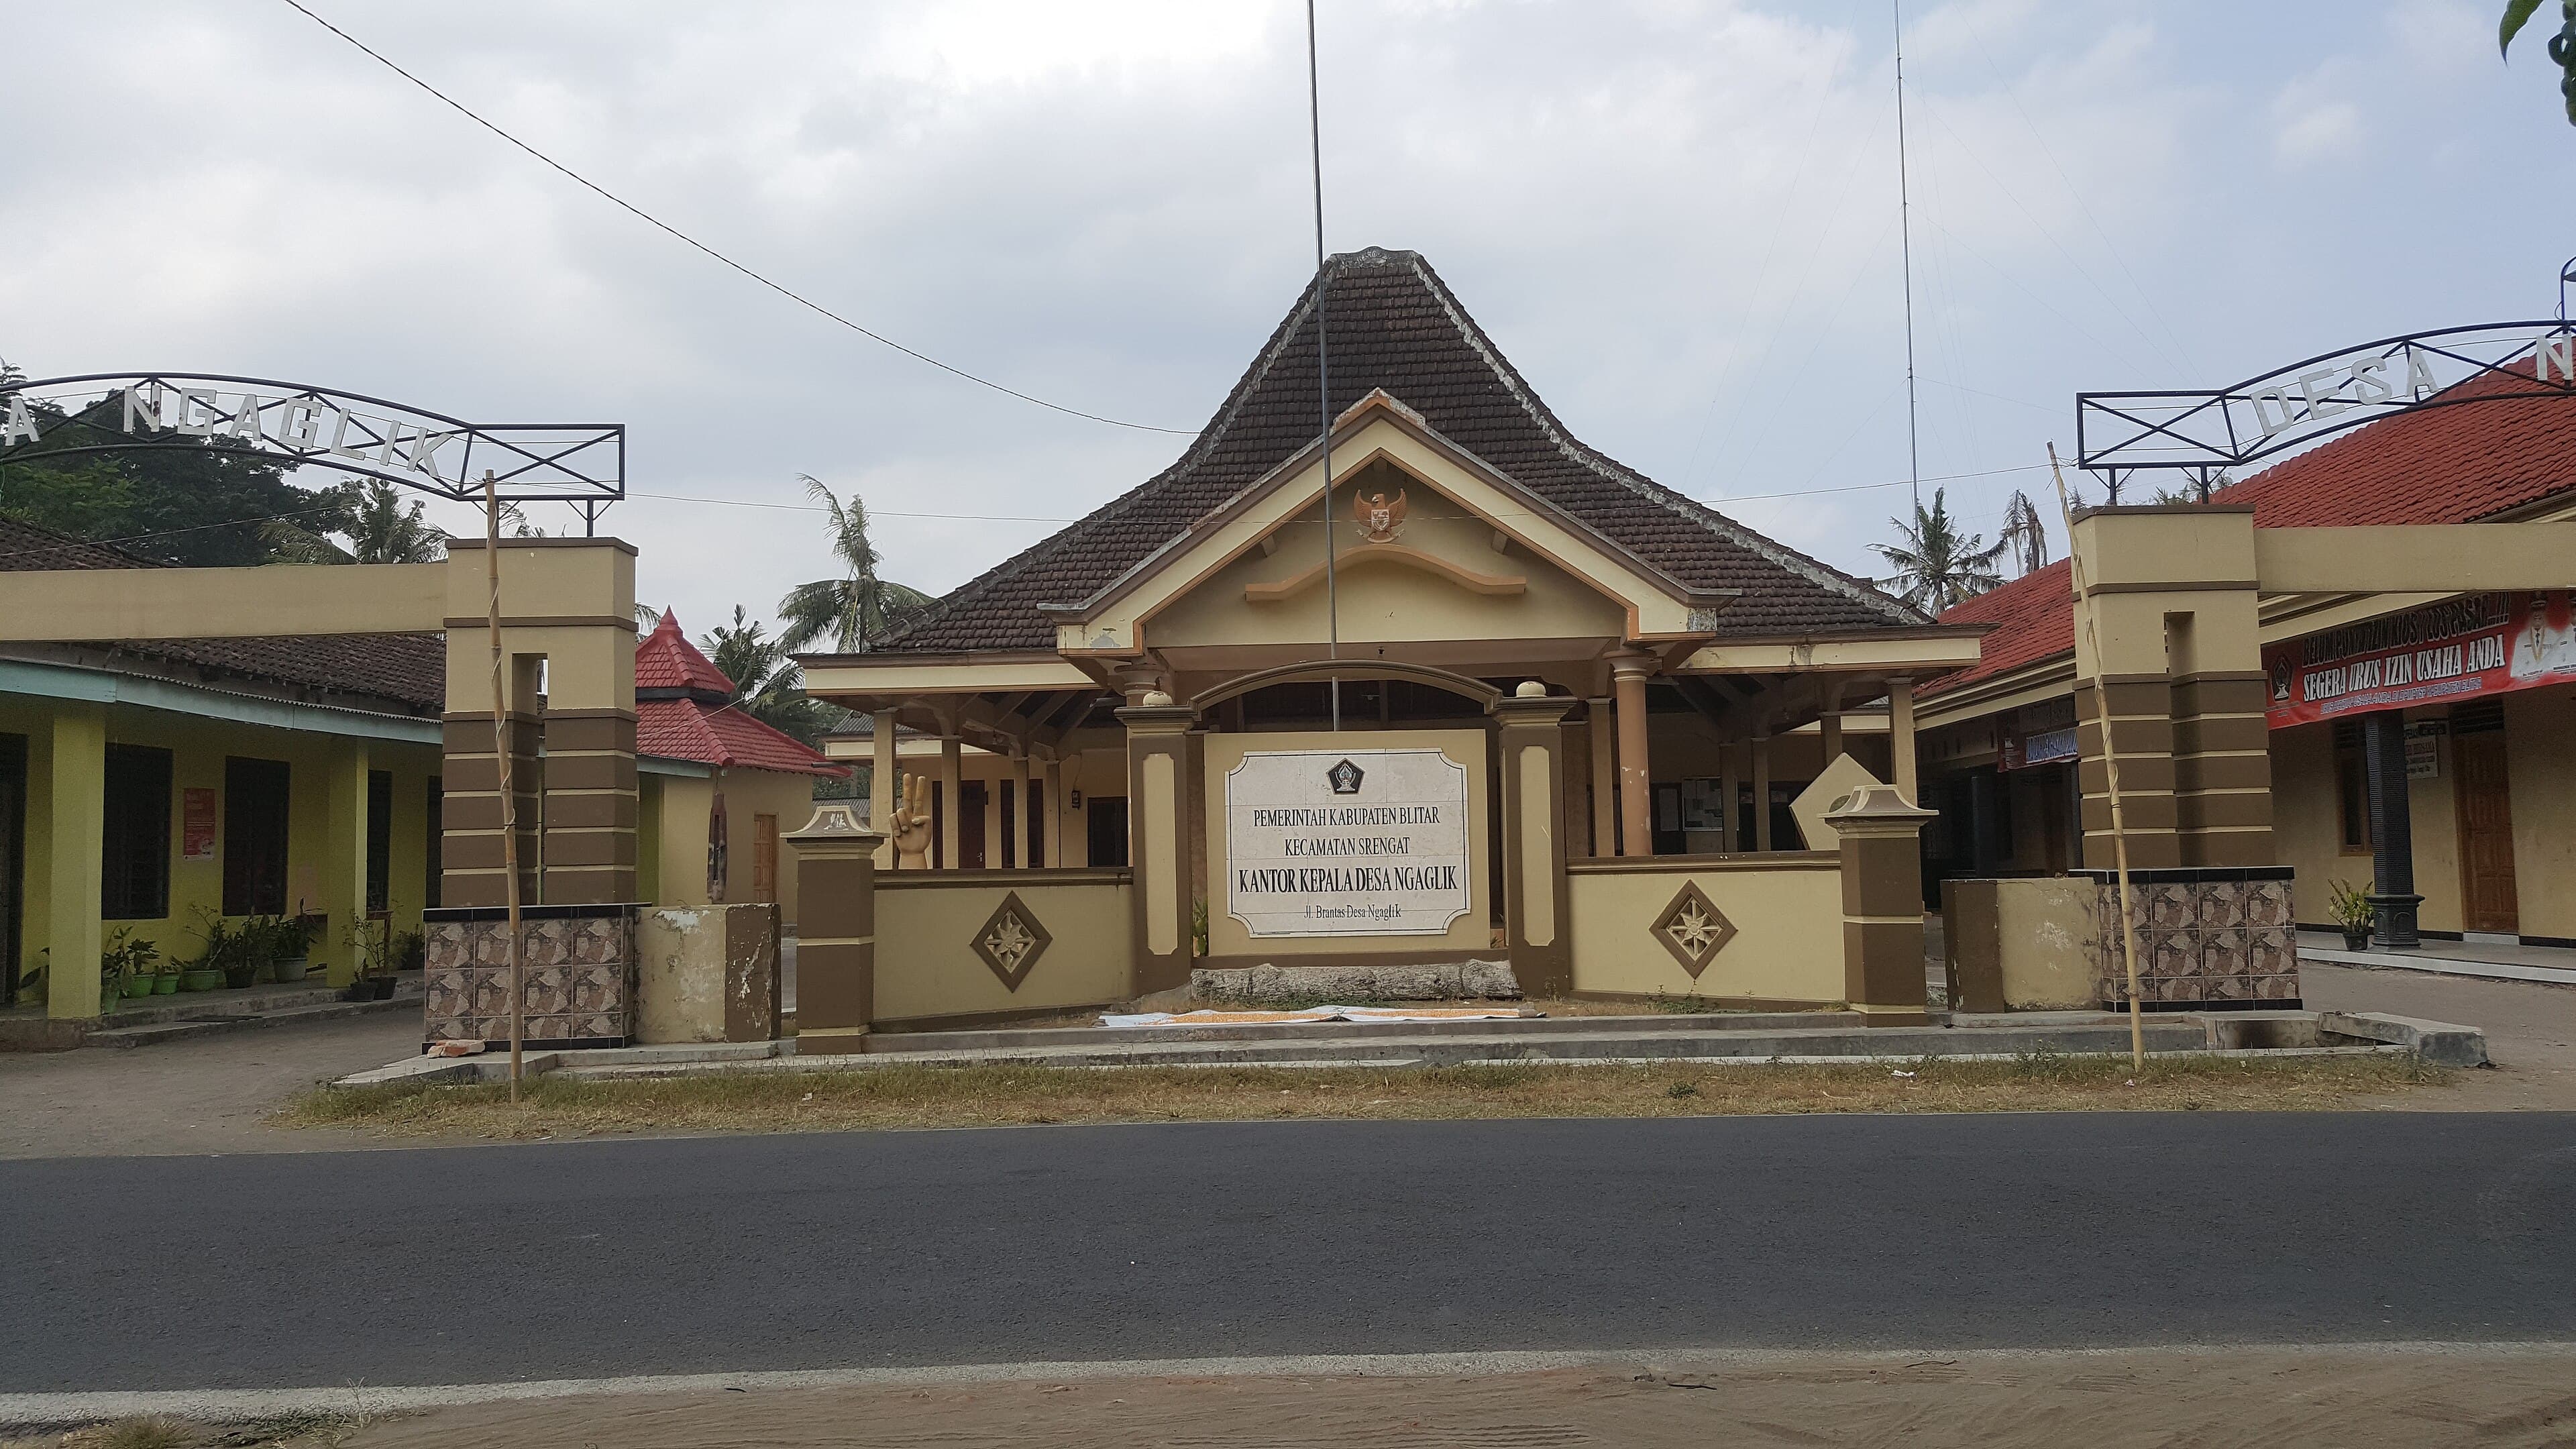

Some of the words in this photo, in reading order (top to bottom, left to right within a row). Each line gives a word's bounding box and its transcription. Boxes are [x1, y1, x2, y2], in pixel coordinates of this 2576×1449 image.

[2249, 348, 2439, 437] DESA
[5, 397, 41, 447] A
[123, 385, 455, 478] NGAGLIK
[2304, 667, 2346, 702] SEGERA
[2349, 659, 2381, 692] URUS
[2383, 653, 2412, 686] IZIN
[2416, 644, 2462, 682] USAHA
[2466, 634, 2506, 673] ANDA
[1254, 808, 1326, 826] PEMERINTAH
[1329, 808, 1397, 826] KABUPATEN
[1399, 806, 1440, 824] BLITAR
[1285, 838, 1355, 856] KECAMATAN
[1358, 837, 1410, 855] SRENGAT
[1239, 869, 1297, 893] KANTOR
[1299, 868, 1354, 892] KEPALA
[1355, 867, 1392, 892] DESA
[1394, 865, 1458, 891] NGAGLIK
[1303, 905, 1313, 918] Jl.
[1316, 905, 1345, 918] Brantas
[1346, 904, 1366, 918] Desa
[1368, 904, 1401, 921] Ngaglik
